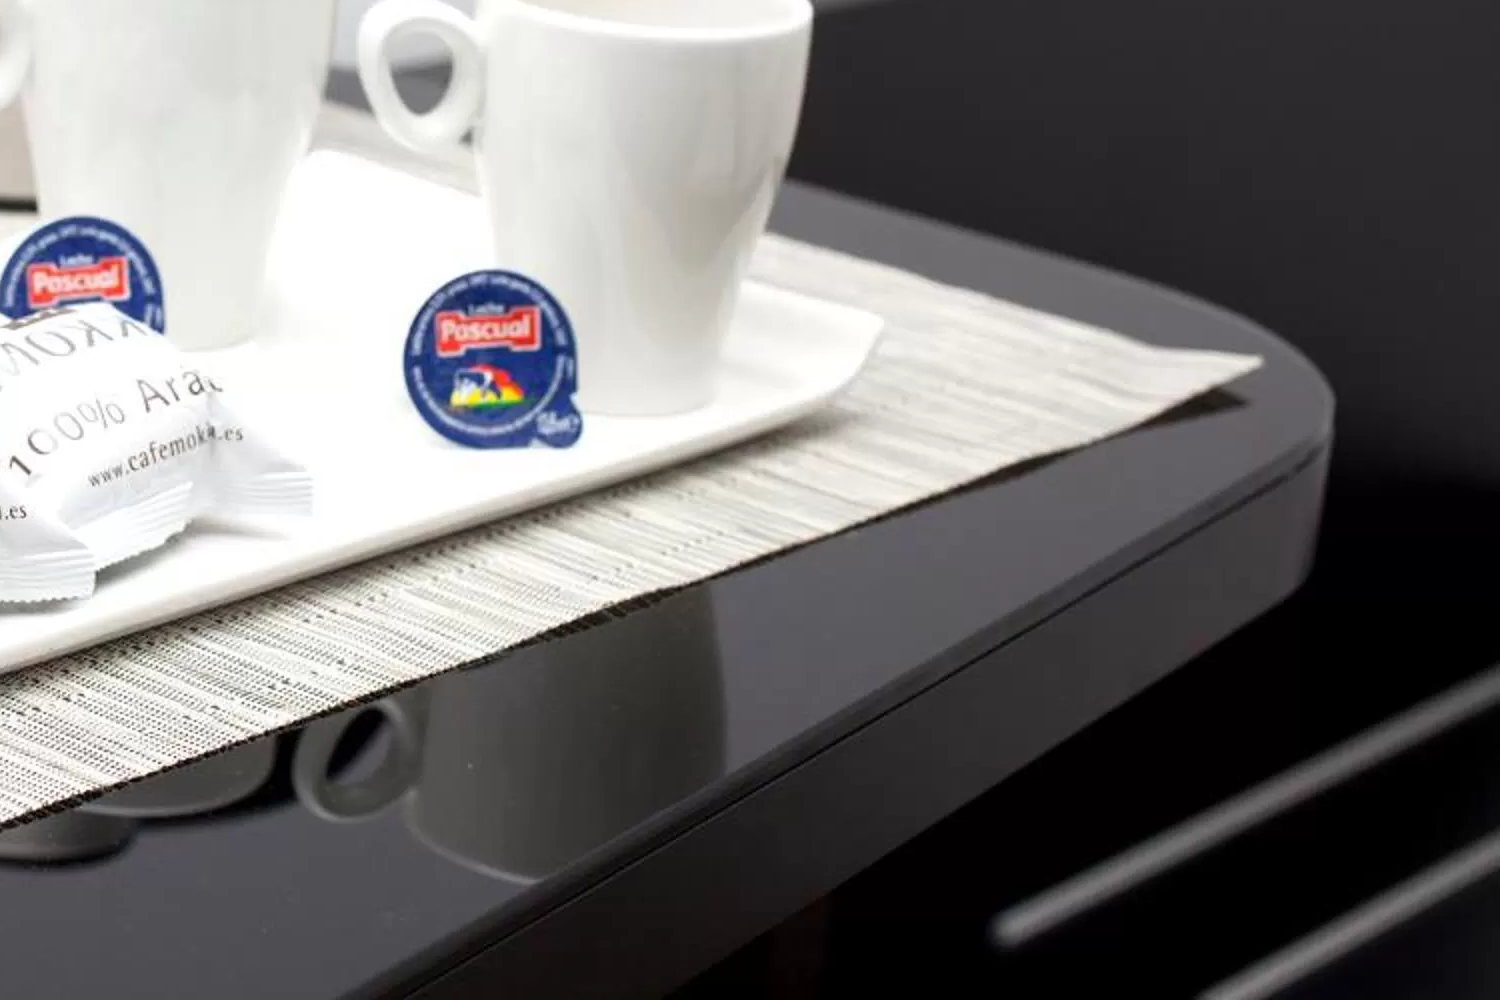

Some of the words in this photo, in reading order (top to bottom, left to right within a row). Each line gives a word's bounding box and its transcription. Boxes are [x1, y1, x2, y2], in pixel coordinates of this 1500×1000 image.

[33, 263, 120, 295] Pascual
[440, 314, 532, 343] Pascual
[8, 396, 126, 478] 100%
